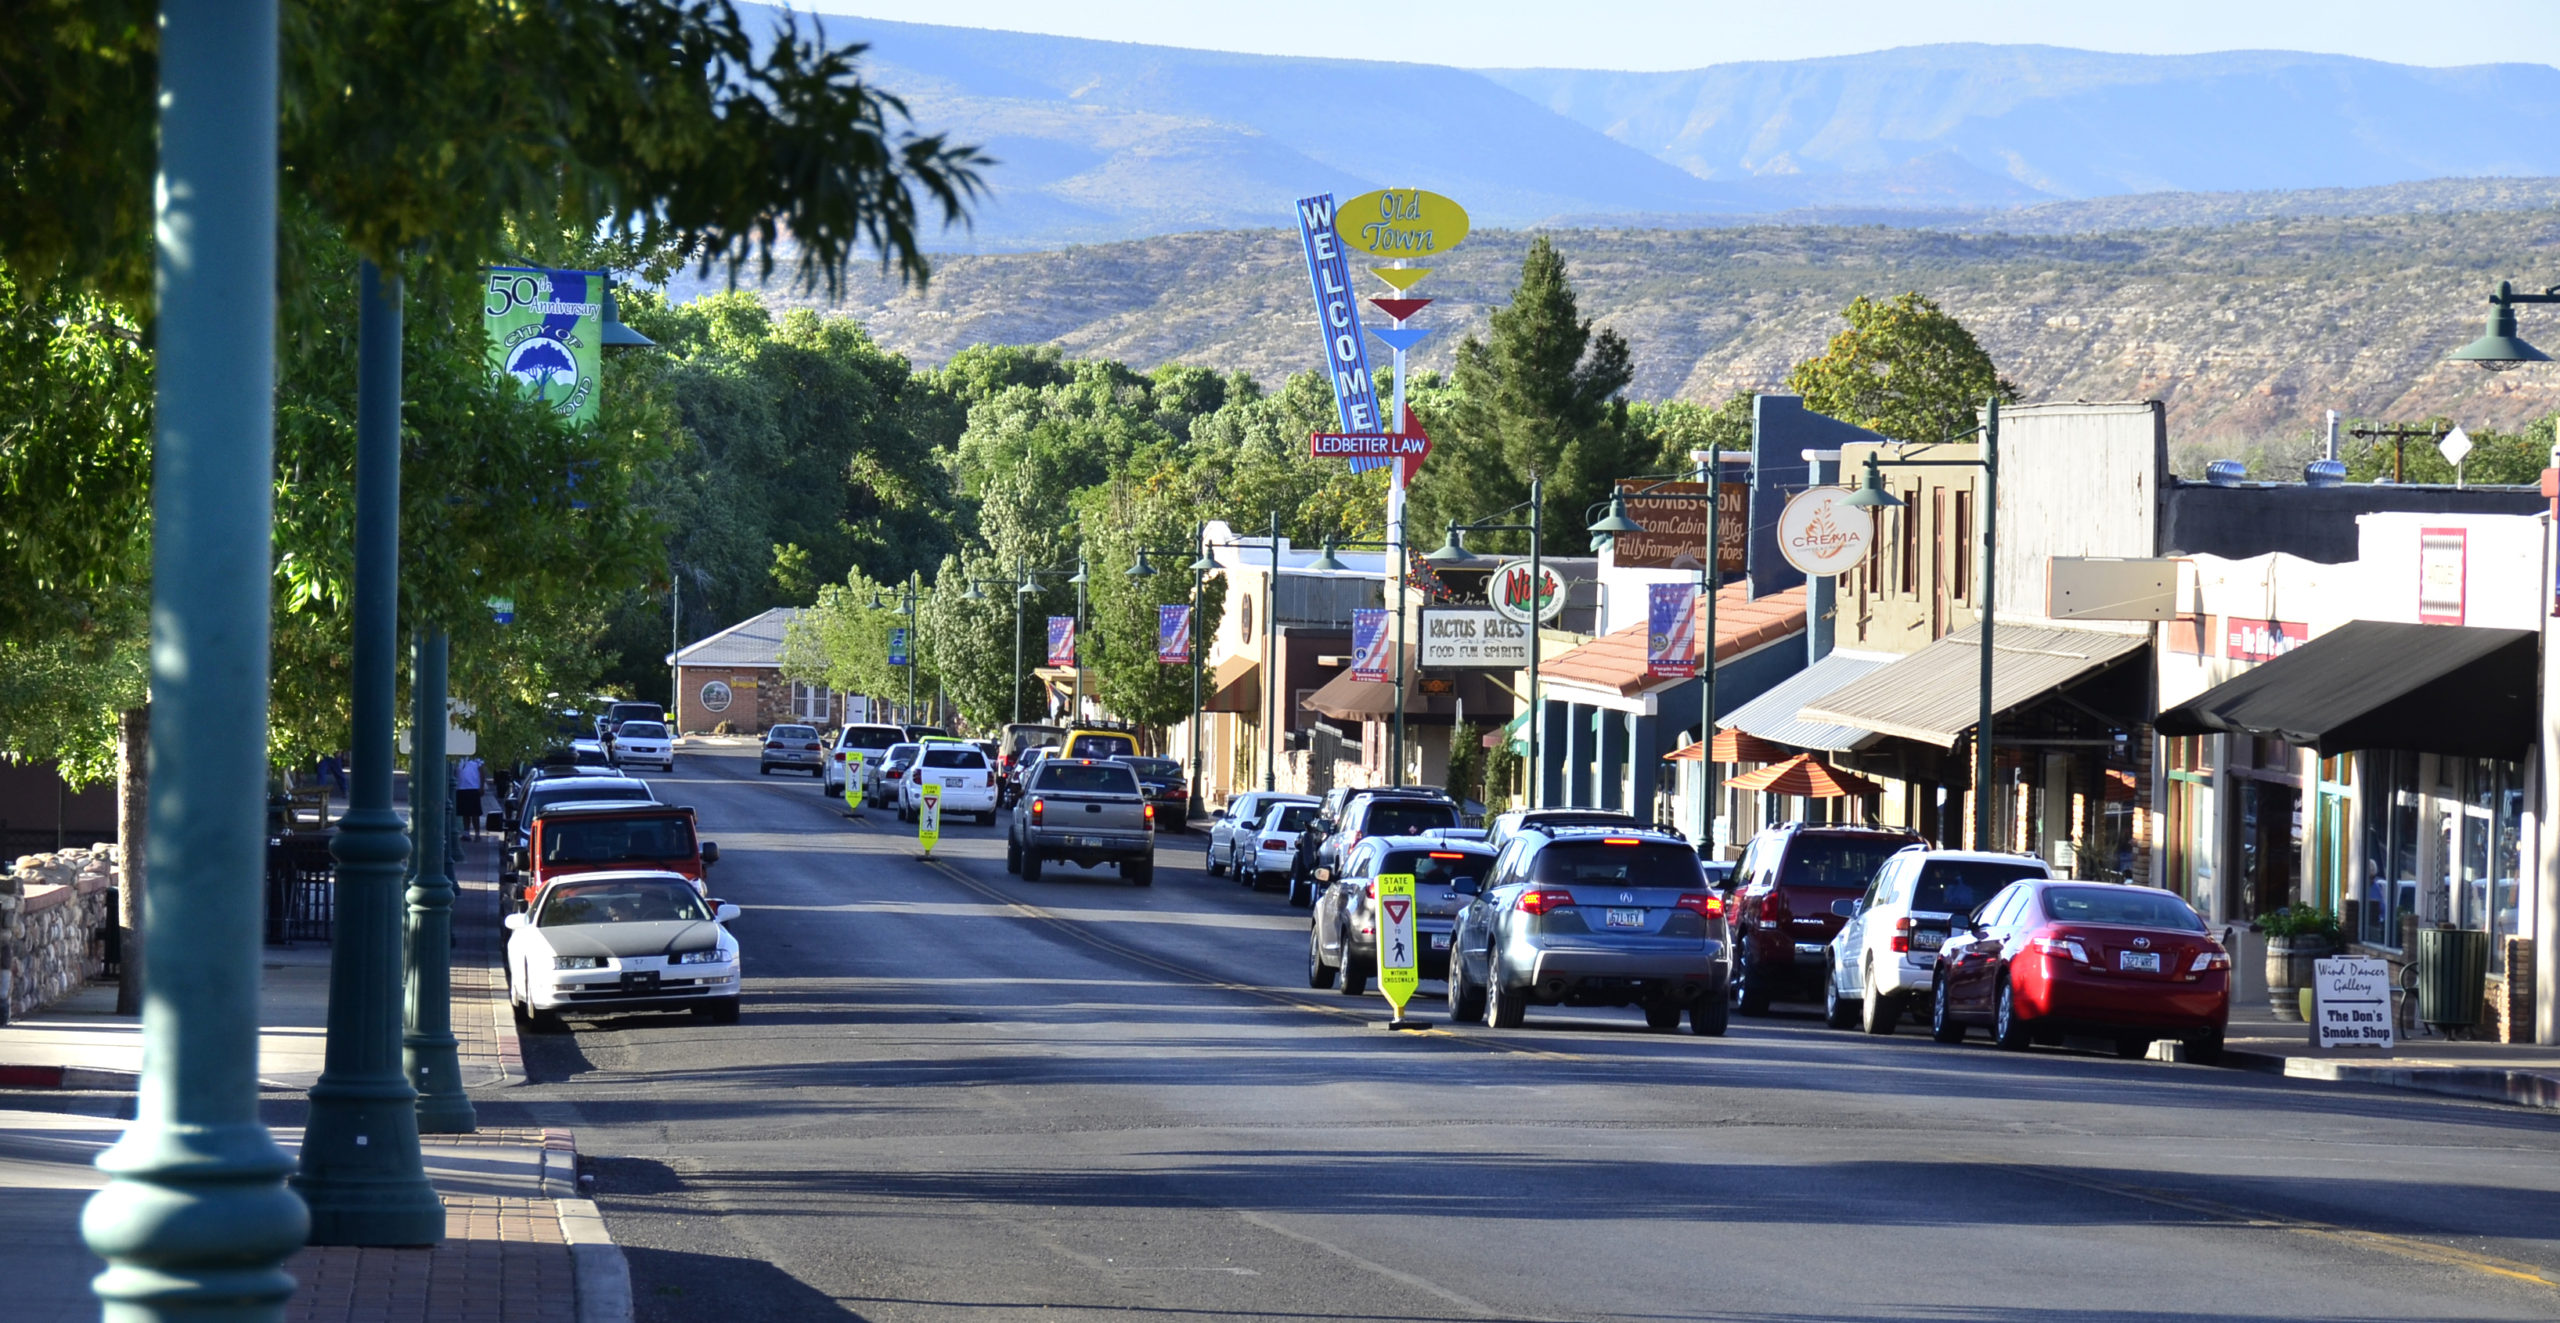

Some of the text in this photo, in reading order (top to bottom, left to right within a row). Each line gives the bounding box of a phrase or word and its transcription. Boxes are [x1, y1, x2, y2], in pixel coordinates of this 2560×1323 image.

[1380, 192, 1421, 221] Old
[1362, 221, 1435, 251] Town
[529, 297, 600, 321] Anniversary
[1302, 200, 1373, 431] WELCOME
[504, 323, 584, 349] CITY OF
[1315, 437, 1425, 454] LEDBETTER LAW
[1718, 493, 1741, 512] ON
[1792, 532, 1861, 547] CREMA
[1429, 618, 1525, 638] KACTUS KATES
[1429, 645, 1525, 658] FOOD FUN SPIRITS
[1384, 877, 1408, 885] STATE
[2318, 963, 2386, 977] Wind Dancer
[2333, 978, 2372, 995] Gallery
[2327, 1010, 2383, 1022] The Don's
[2322, 1026, 2390, 1041] Smoke Shop
